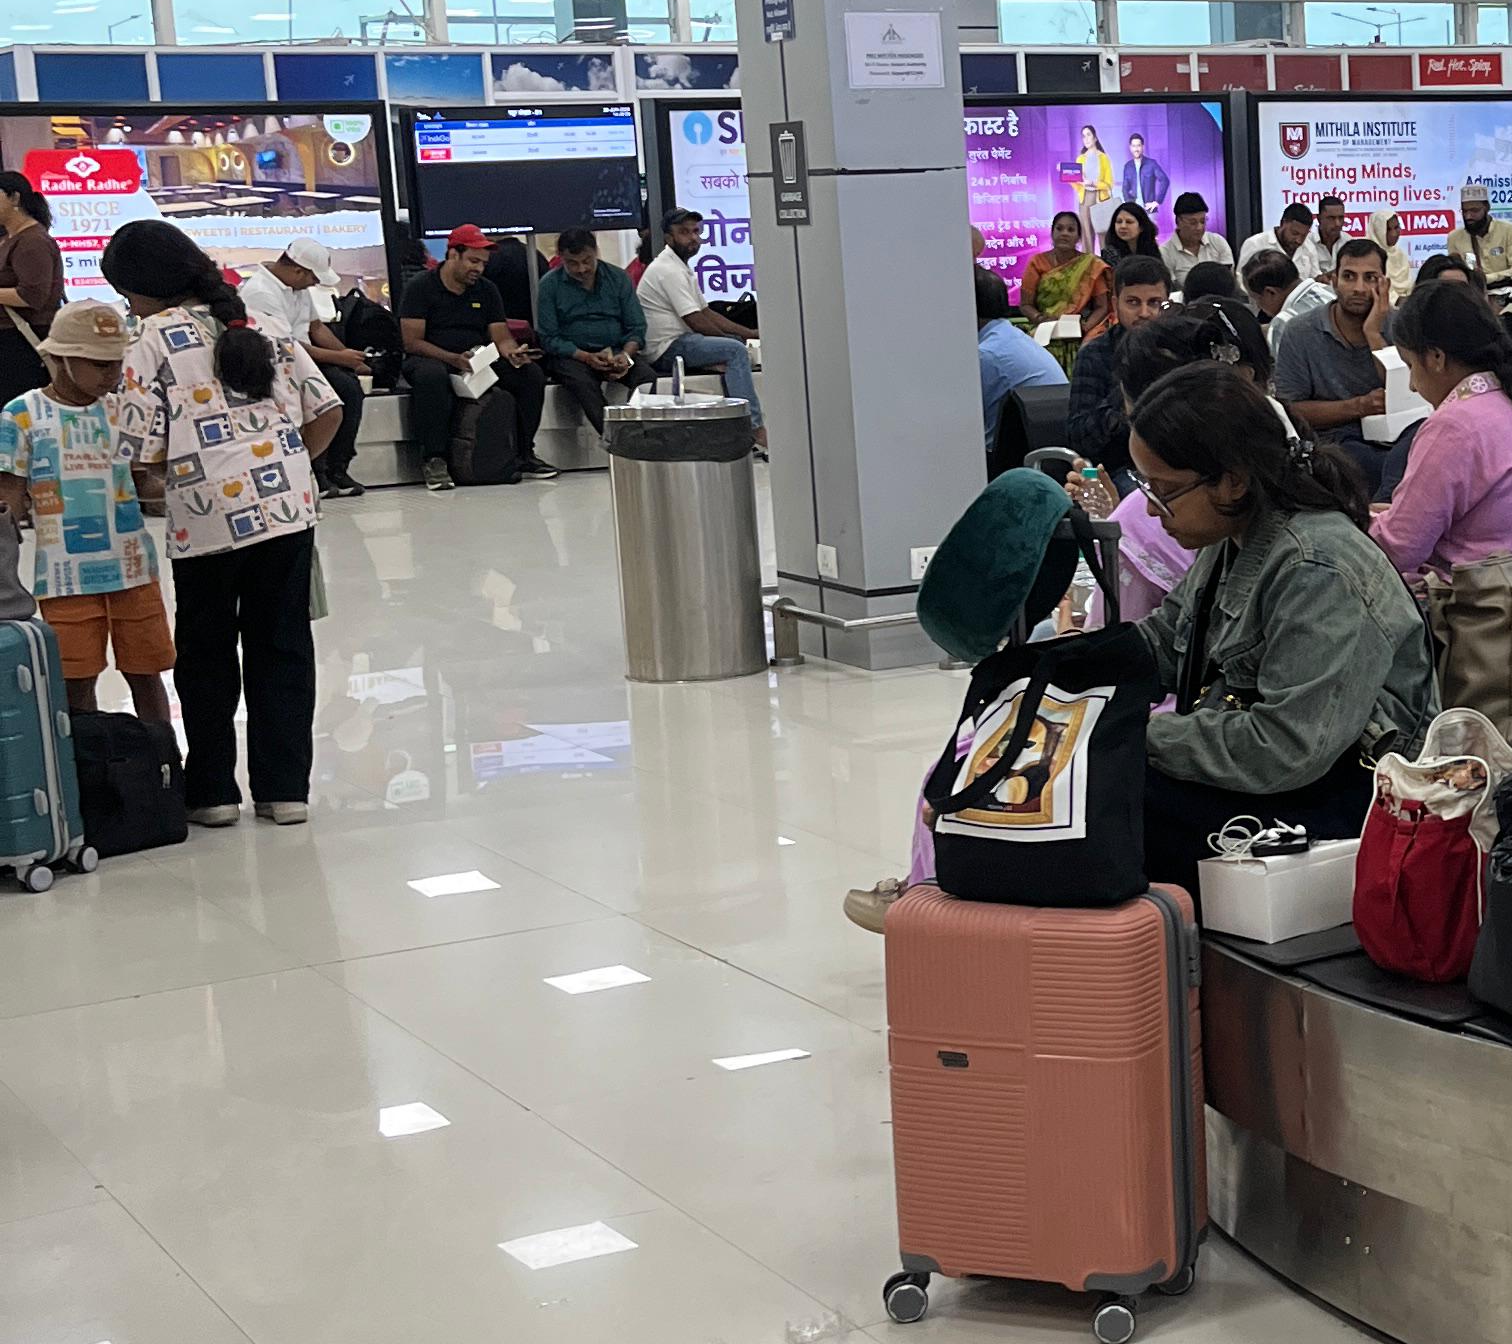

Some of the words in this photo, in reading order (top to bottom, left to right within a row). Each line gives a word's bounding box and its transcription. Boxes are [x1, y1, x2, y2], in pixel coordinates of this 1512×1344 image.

[1006, 110, 1020, 137] है
[1315, 122, 1361, 138] MITHILA
[1363, 121, 1418, 138] INSTITUTE
[700, 169, 740, 190] सबको
[1361, 162, 1417, 181] Minds,
[40, 179, 82, 192] Radhe
[1282, 186, 1400, 207] Transforming
[59, 201, 121, 217] SINCE
[71, 218, 113, 234] 1971
[240, 226, 314, 236] RESTAURANT
[323, 224, 368, 234] BAKERY
[1414, 213, 1450, 230] MCA
